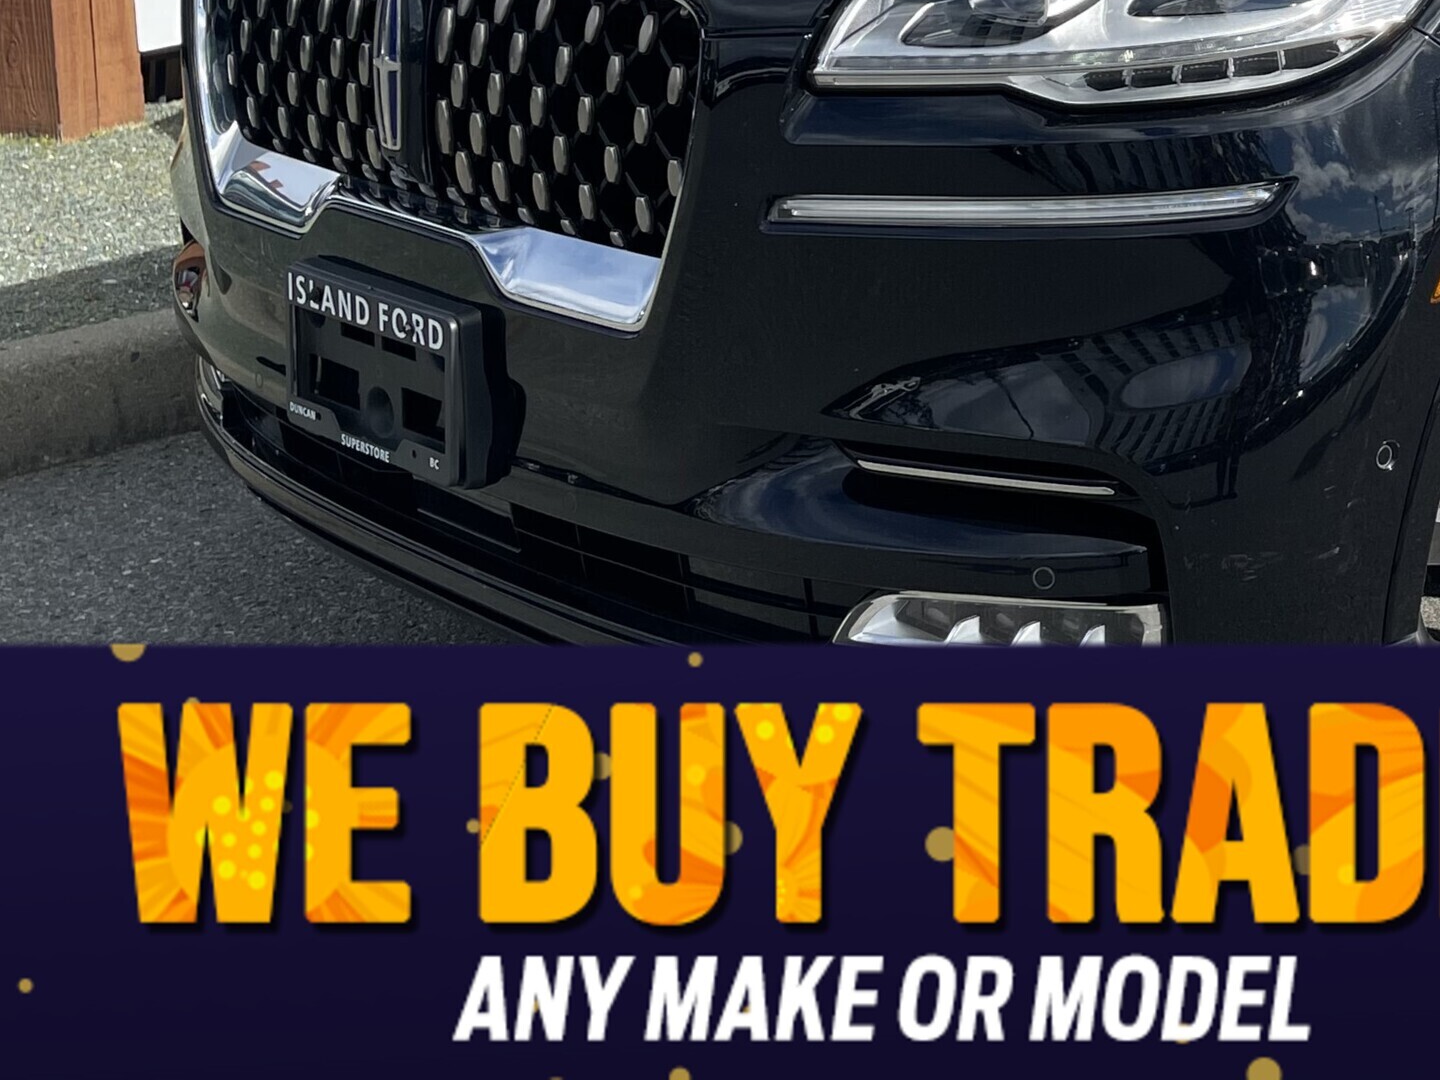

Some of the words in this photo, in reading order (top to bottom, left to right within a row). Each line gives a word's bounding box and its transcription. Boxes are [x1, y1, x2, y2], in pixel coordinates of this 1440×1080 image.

[288, 272, 370, 326] ISLAND
[378, 302, 444, 350] FORD
[289, 401, 316, 420] DUNCAN
[341, 433, 390, 463] SUPERSTORE
[429, 457, 440, 470] BC
